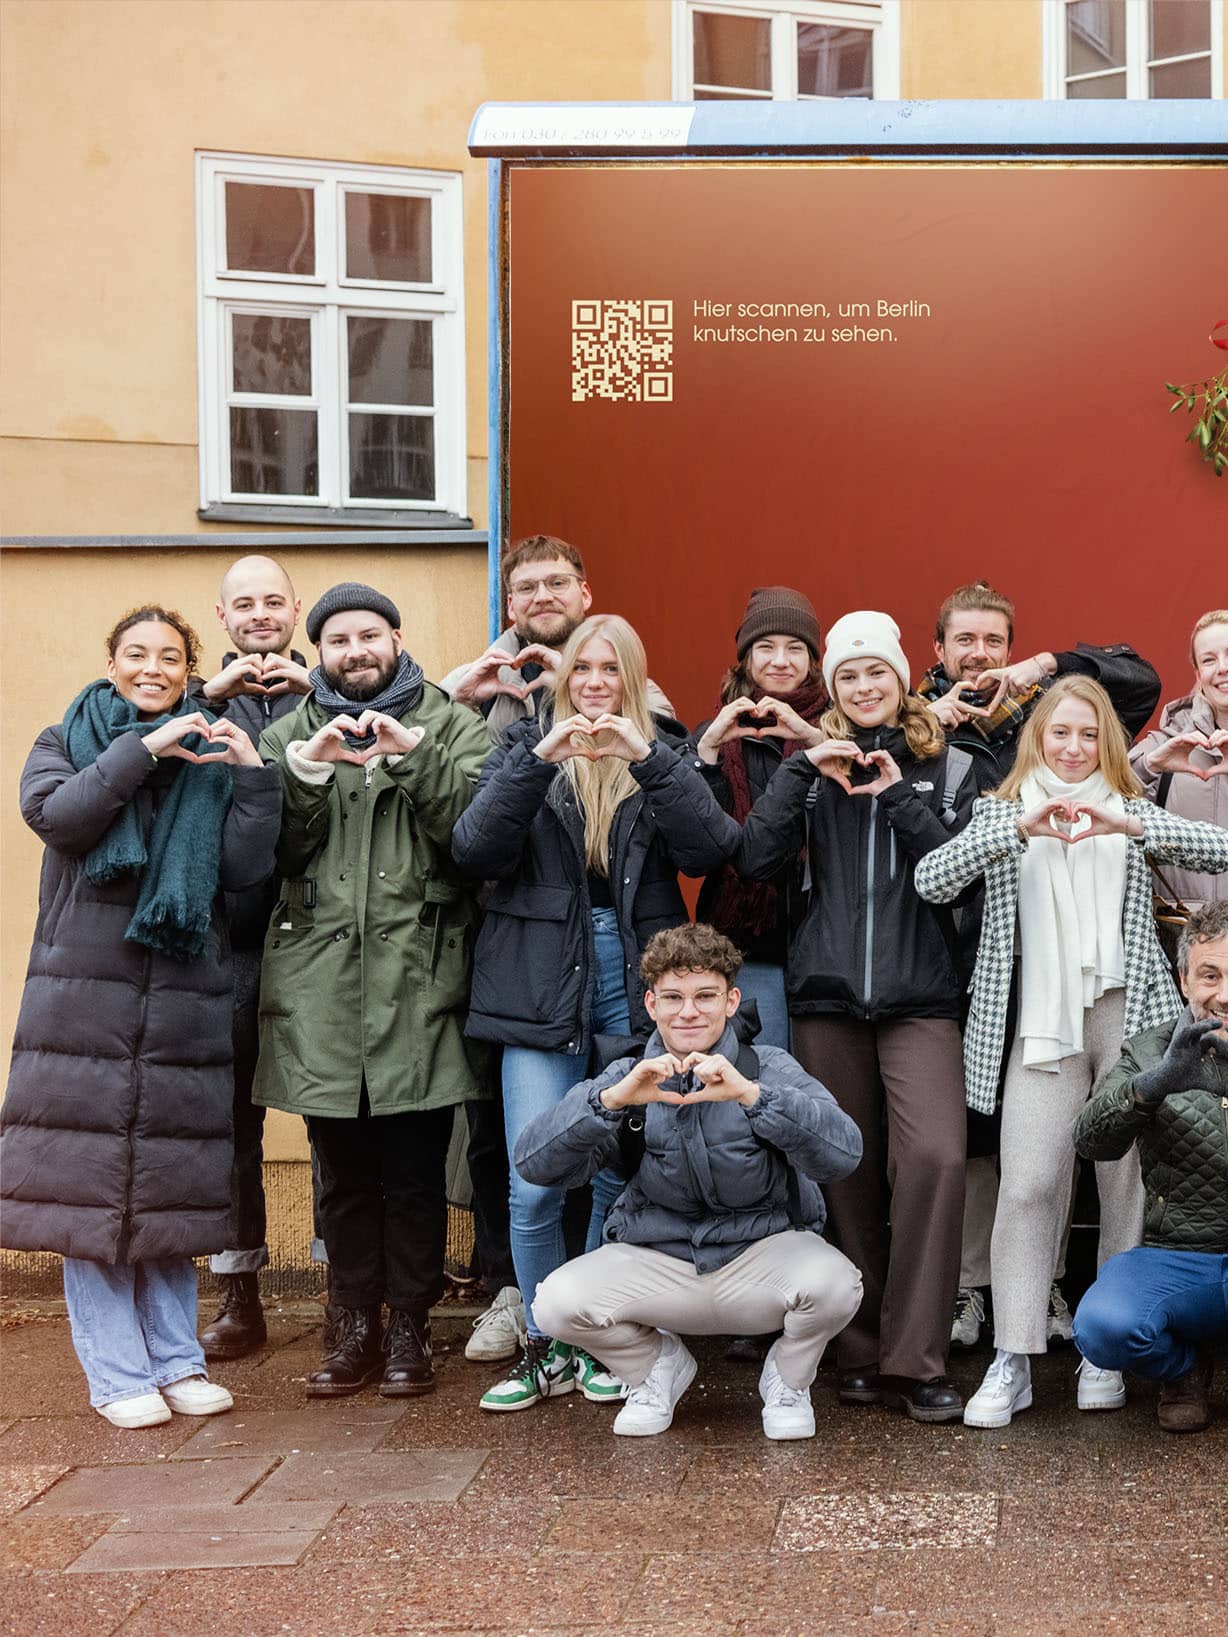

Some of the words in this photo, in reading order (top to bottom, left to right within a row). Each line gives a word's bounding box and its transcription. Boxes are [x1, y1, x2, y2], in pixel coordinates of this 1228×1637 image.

[693, 299, 733, 317] Hier
[738, 303, 831, 319] scannen,
[839, 304, 870, 317] um
[877, 299, 931, 317] Berlin
[693, 325, 798, 342] knutschen
[803, 328, 826, 342] zu
[831, 325, 898, 342] sehen.
